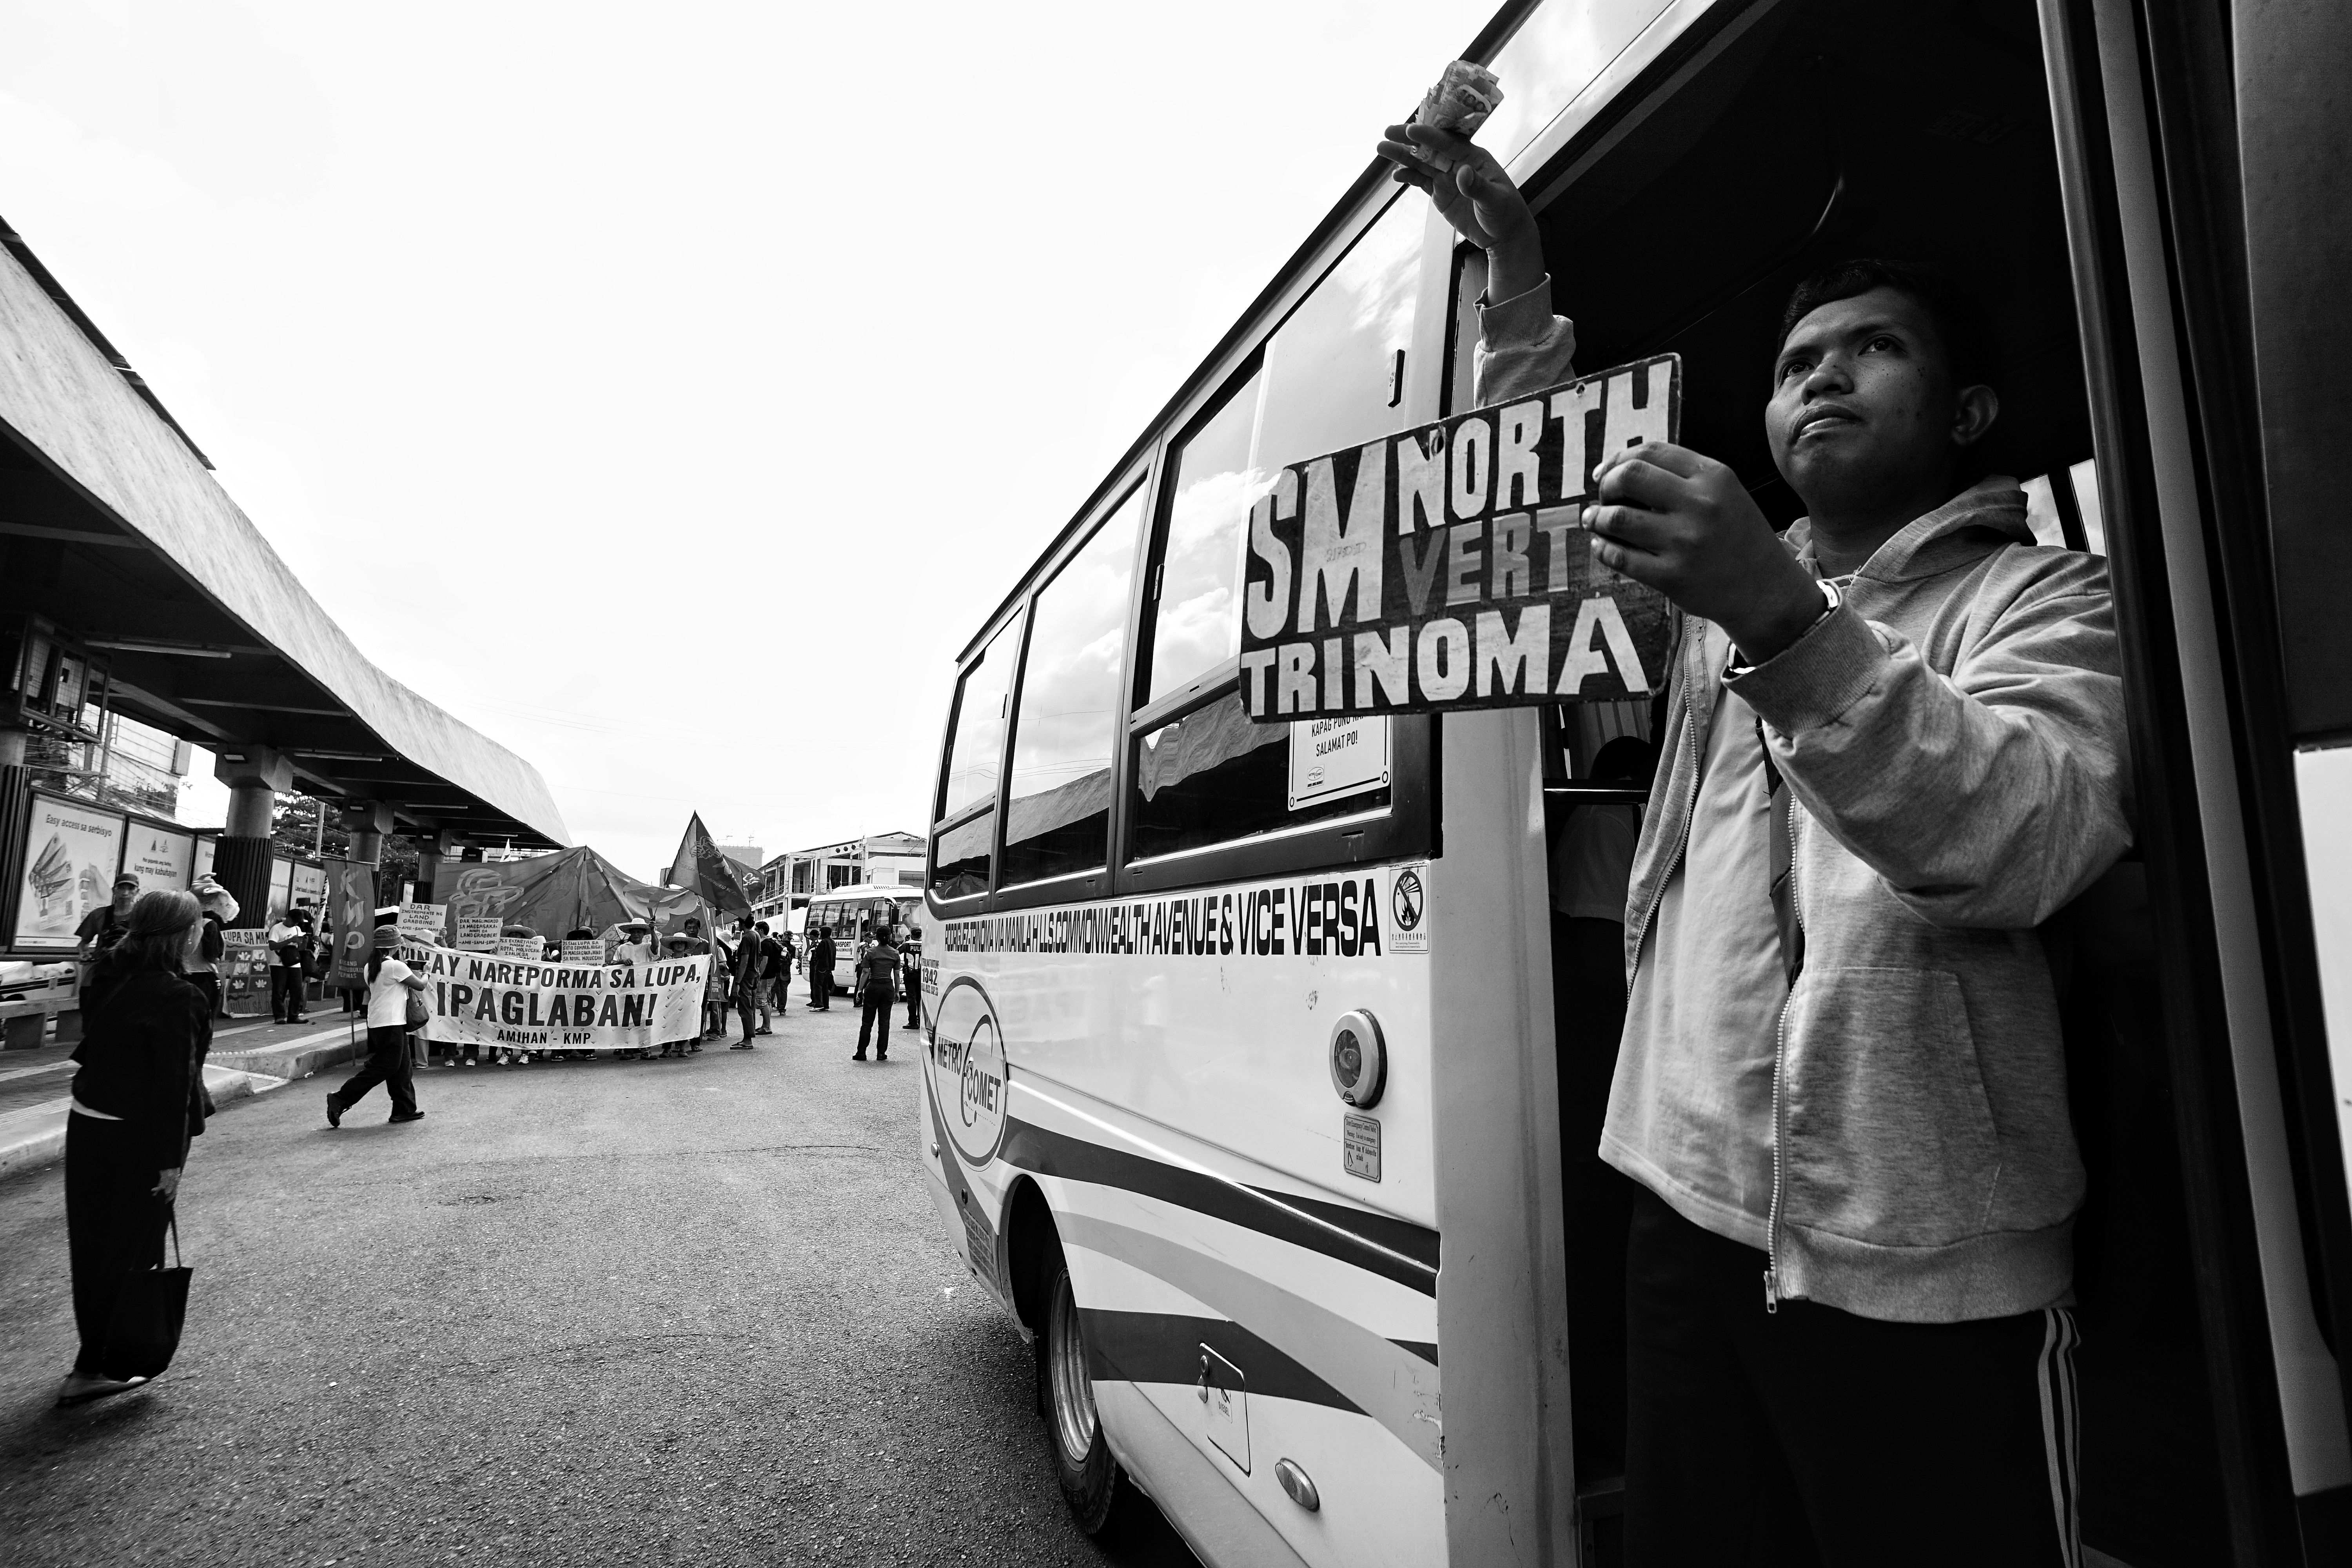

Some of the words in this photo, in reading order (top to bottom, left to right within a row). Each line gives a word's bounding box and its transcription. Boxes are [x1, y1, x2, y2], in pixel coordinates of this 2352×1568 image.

[1397, 360, 1673, 536] NORTH
[1247, 439, 1388, 640] SM
[1241, 595, 1649, 717] TRINOMA
[1312, 718, 1332, 737] KAPAG
[1316, 735, 1345, 757] SALAMAT
[1347, 730, 1358, 747] PO!
[995, 917, 1004, 953] VIA
[1005, 915, 1031, 953] MANILA
[1151, 896, 1218, 956] AVENUE
[1220, 894, 1234, 955] &
[1238, 888, 1285, 956] VICE
[1290, 878, 1381, 957] VERSA
[223, 931, 242, 942] LUPA
[244, 931, 254, 945] SA
[610, 969, 635, 988] SA
[644, 964, 701, 987] LUPA,
[922, 967, 937, 986] 1342
[437, 982, 658, 1027] IPAGLABAN!
[497, 1029, 547, 1044] AMIHAN
[564, 1033, 591, 1044] KMP
[937, 1036, 962, 1075] METRO
[967, 1065, 1001, 1114] COMET
[1218, 1401, 1230, 1417] DIESEL
